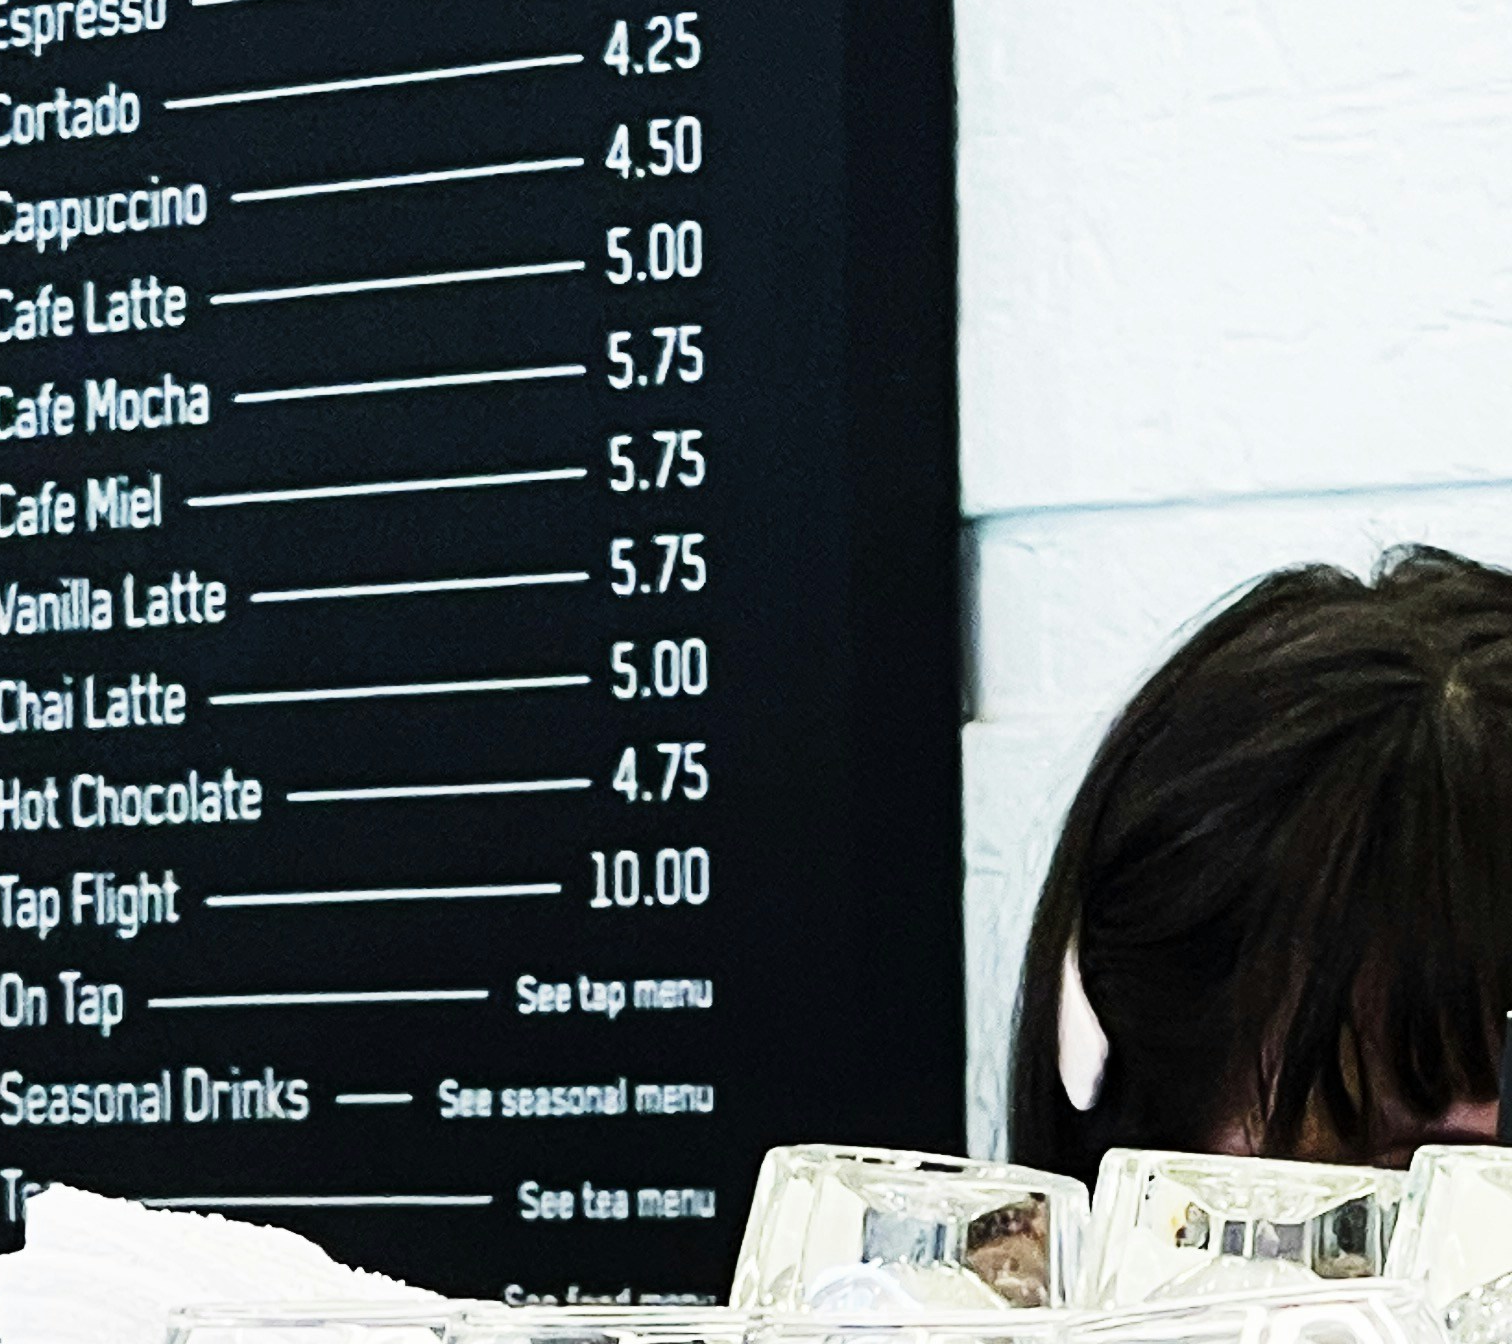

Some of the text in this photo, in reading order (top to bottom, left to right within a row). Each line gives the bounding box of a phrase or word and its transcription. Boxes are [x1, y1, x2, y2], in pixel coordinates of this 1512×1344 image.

[603, 11, 701, 77] 4.25
[605, 115, 702, 180] 4.50
[85, 274, 187, 334] Latte
[606, 219, 703, 285] 5.00
[85, 372, 210, 432] Mocha
[607, 325, 704, 390] 5.75
[86, 473, 162, 532] Miel
[609, 429, 706, 492] 5.75
[123, 571, 227, 629] Latte
[610, 532, 707, 596] 5.75
[84, 673, 187, 729] Latte
[611, 637, 708, 700] 5.00
[71, 768, 263, 828] Chocolate
[612, 742, 709, 802] 4.75
[71, 869, 181, 939] Flight
[590, 846, 710, 909] 10.00
[58, 971, 124, 1037] Tap
[516, 974, 572, 1015] See
[578, 975, 626, 1019] tap
[633, 979, 713, 1009] menu
[183, 1066, 309, 1123] Drinks
[438, 1078, 493, 1119] See
[501, 1077, 627, 1118] seasonal
[635, 1084, 714, 1114] menu
[519, 1180, 716, 1220] See tea menu
